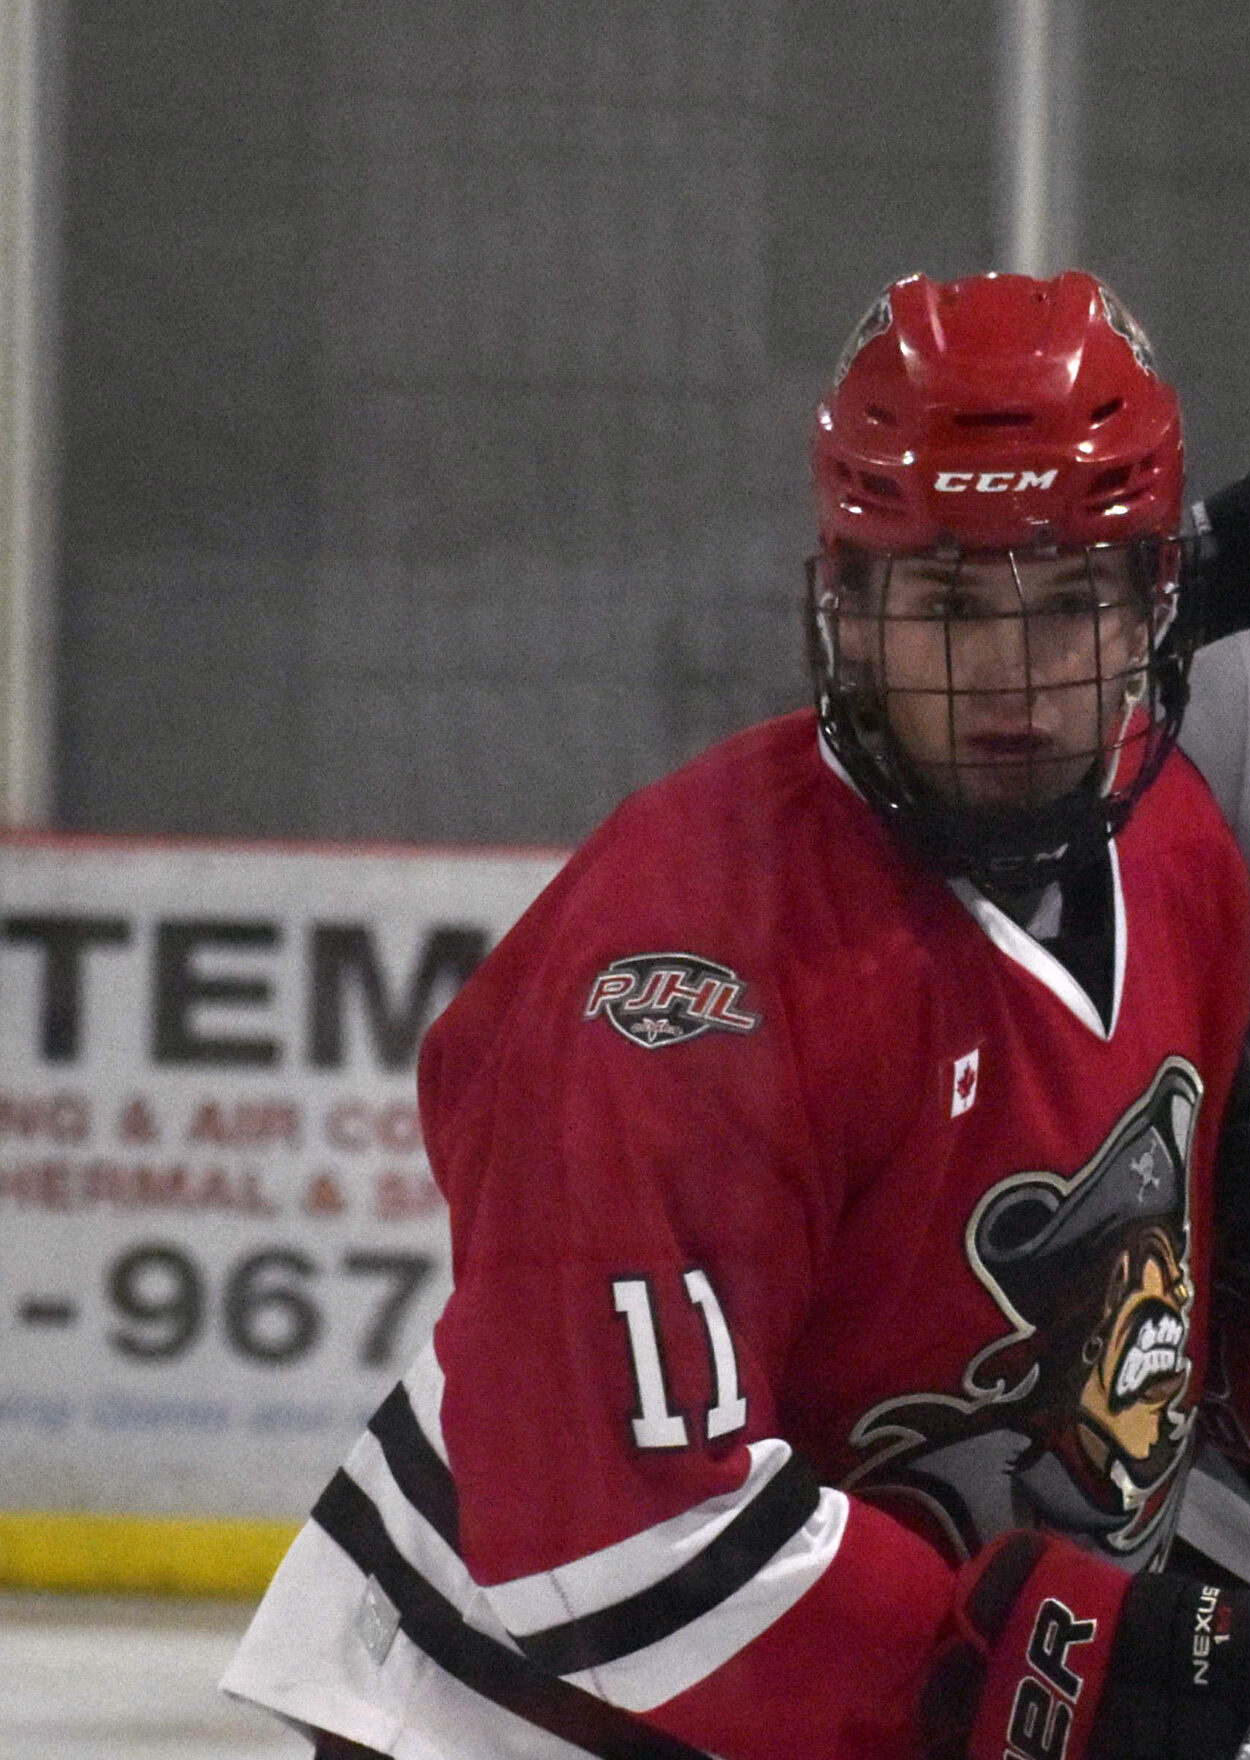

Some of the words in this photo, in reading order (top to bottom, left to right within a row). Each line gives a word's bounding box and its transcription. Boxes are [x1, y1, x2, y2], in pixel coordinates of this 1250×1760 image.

[934, 468, 1059, 492] CCM
[584, 966, 759, 1031] PJHL
[611, 1268, 748, 1449] 11
[1192, 1584, 1221, 1685] NEXUS
